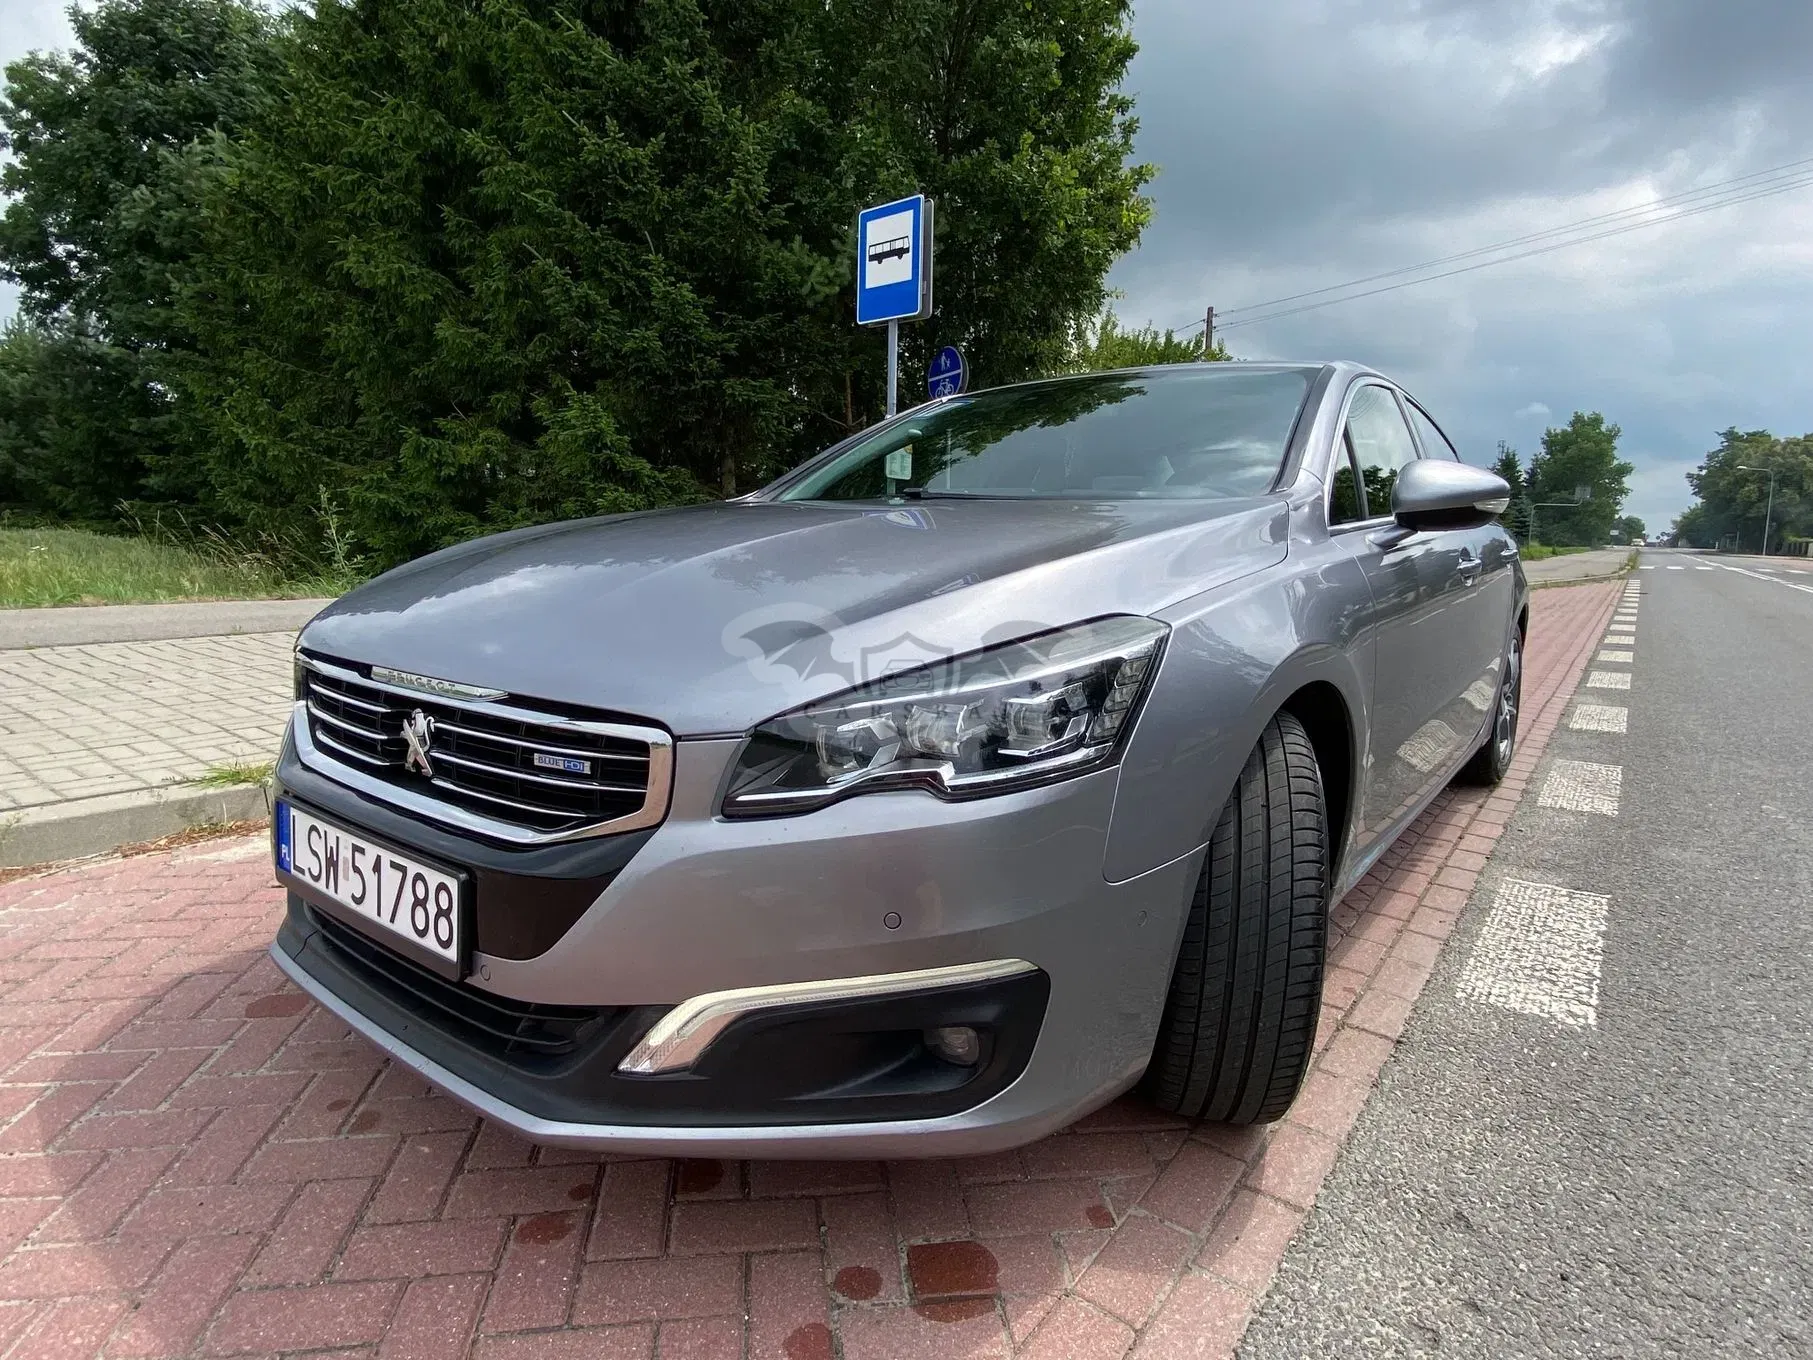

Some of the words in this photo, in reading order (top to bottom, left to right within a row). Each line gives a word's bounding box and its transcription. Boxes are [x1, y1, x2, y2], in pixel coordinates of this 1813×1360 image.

[387, 670, 456, 692] PEUGEOT
[538, 756, 561, 767] BLUE
[281, 844, 291, 861] PL
[292, 814, 340, 895] LSW
[350, 842, 454, 950] 51788
